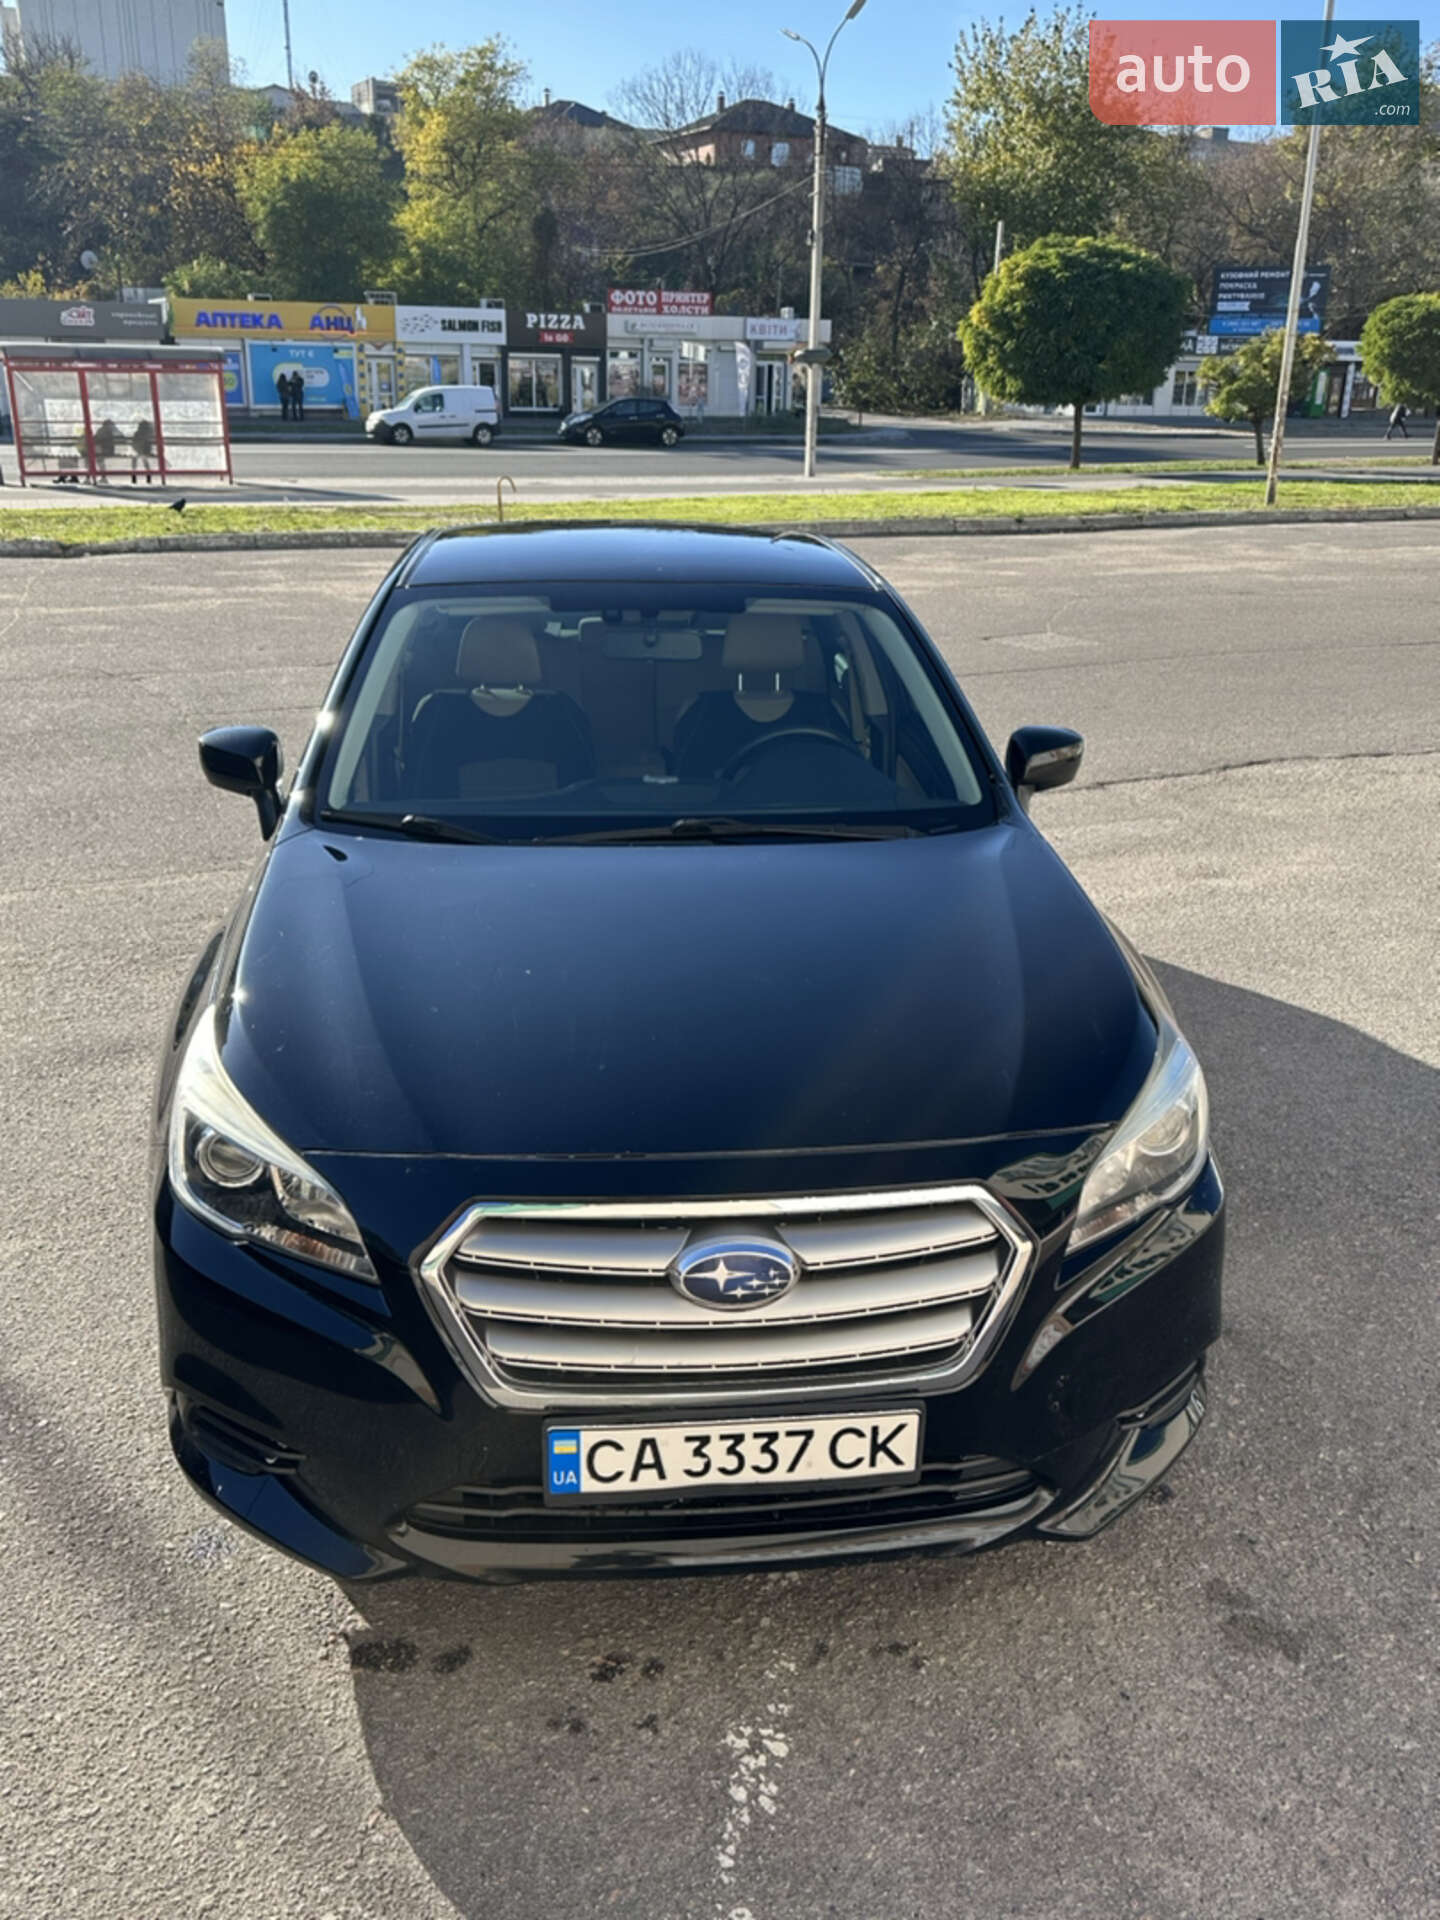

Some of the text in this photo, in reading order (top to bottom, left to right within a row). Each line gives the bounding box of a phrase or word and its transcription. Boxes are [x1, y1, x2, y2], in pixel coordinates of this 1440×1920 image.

[1260, 271, 1290, 279] РЕМОНТ
[610, 290, 657, 305] ФОТО
[661, 304, 709, 315] ХОЛСТИ
[195, 311, 283, 330] АПТЕКА
[309, 313, 354, 335] АНЦ
[440, 318, 502, 333] SALMON FISH
[525, 312, 586, 330] PIZZA
[750, 324, 788, 336] КВІТИ
[586, 1423, 908, 1484] CA 3337 CK
[553, 1472, 577, 1486] UA
